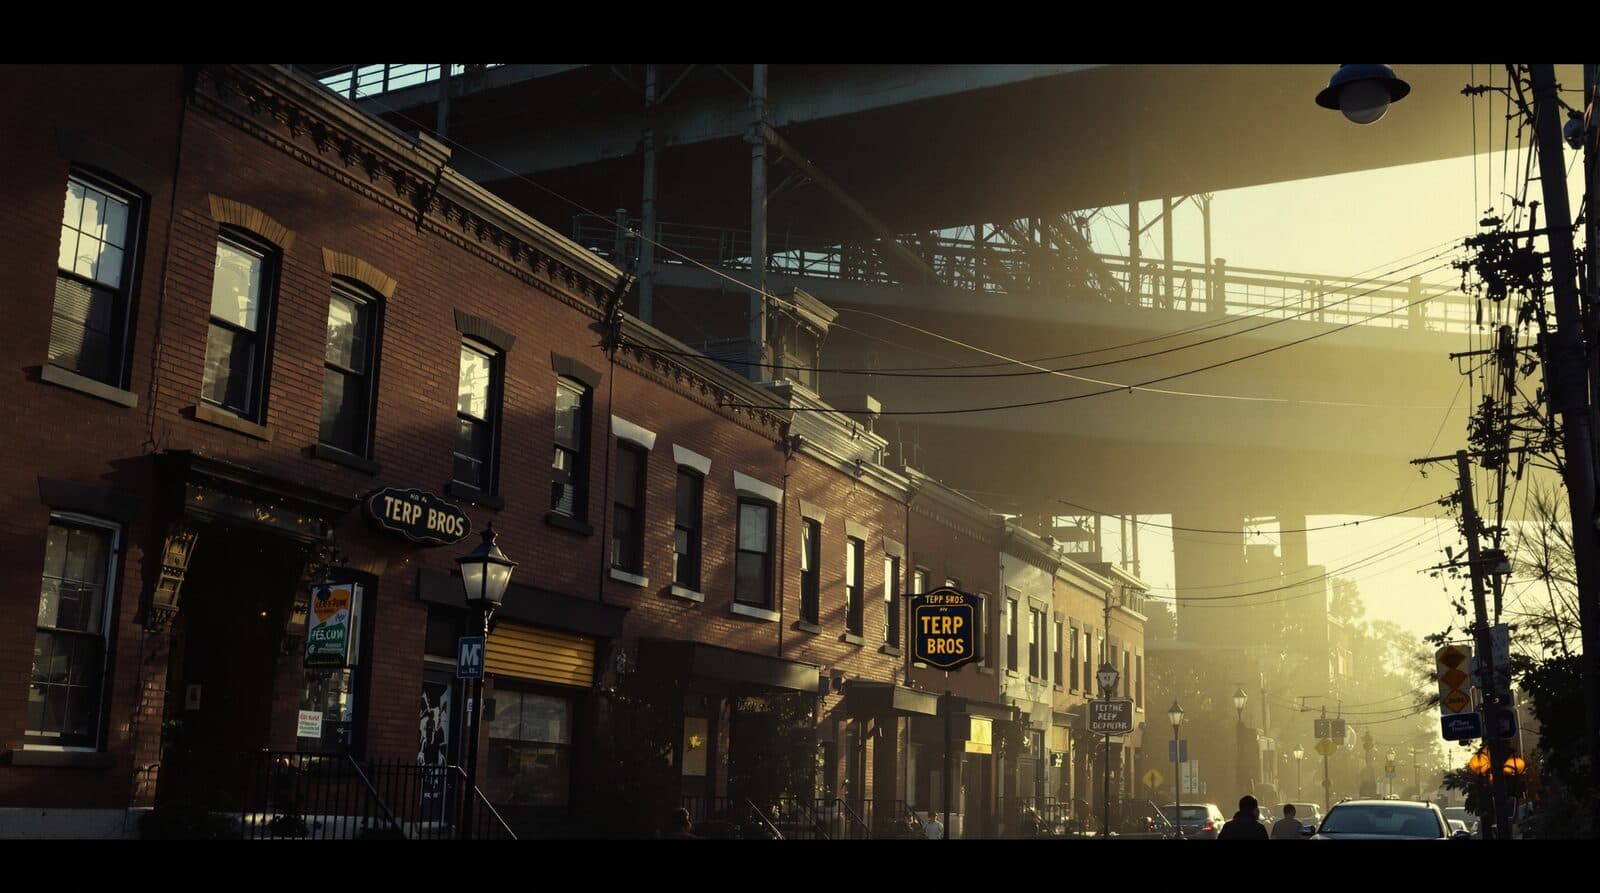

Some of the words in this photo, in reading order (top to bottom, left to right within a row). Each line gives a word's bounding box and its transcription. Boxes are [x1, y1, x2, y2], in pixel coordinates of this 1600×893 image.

[384, 495, 422, 525] TERP
[426, 508, 464, 537] BROS
[920, 615, 964, 635] TERP
[927, 638, 965, 655] BROS
